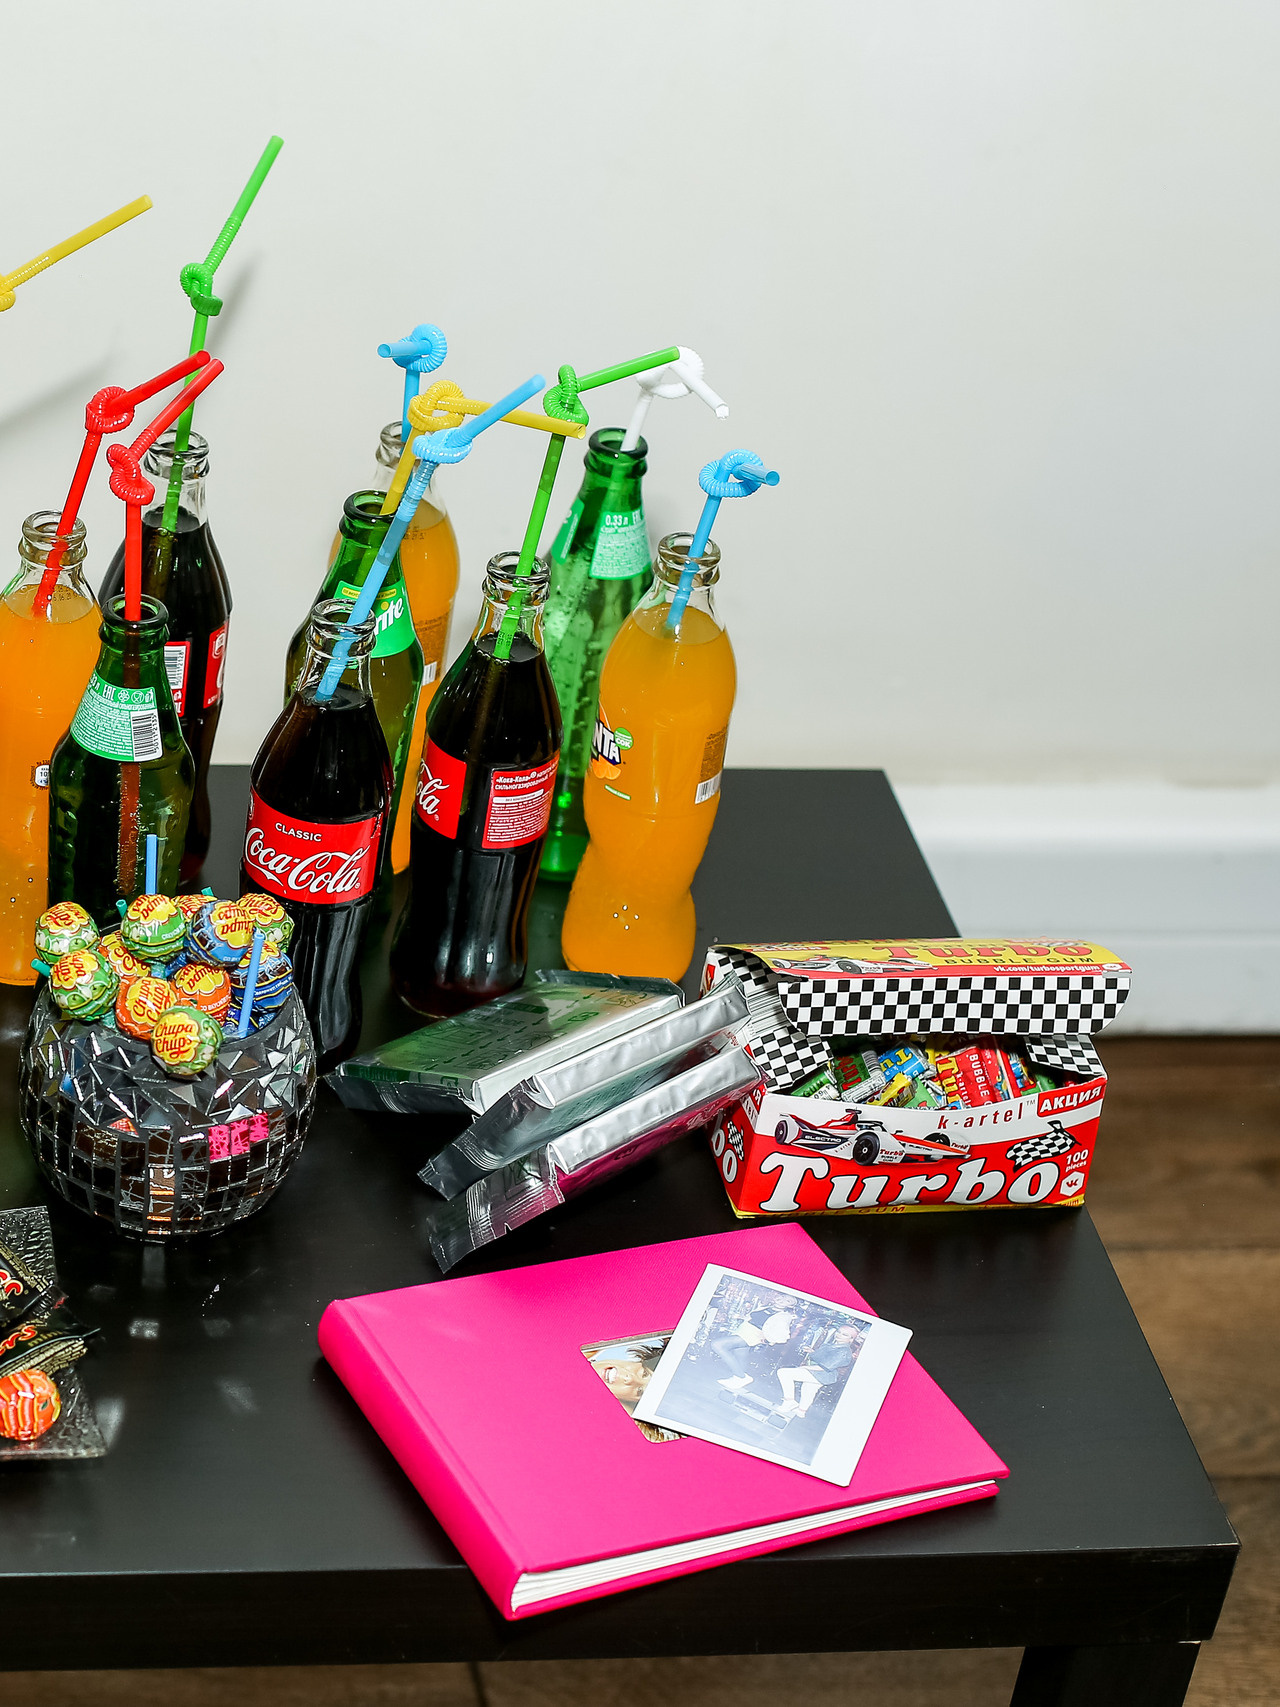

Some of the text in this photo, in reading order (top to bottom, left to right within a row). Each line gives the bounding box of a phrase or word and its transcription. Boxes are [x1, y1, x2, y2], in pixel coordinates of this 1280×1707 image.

[374, 597, 405, 637] rite
[592, 721, 621, 764] NTA
[275, 822, 323, 843] CLASSIC
[245, 827, 371, 894] Coca-Cola
[871, 944, 1093, 960] Turbo
[943, 956, 1095, 965] BUBBLE GUM
[993, 963, 1101, 974] vk.com/turbosportgum
[133, 979, 151, 1018] Chupa
[154, 1022, 193, 1038] Chupa
[154, 1035, 195, 1058] Chups
[936, 1056, 963, 1105] Tur
[970, 1053, 990, 1097] BUBBLE
[1039, 1086, 1102, 1113] АКЦИЯ
[937, 1102, 1023, 1130] k-artel
[804, 1134, 842, 1143] ELECTRO
[879, 1148, 906, 1156] Turbo
[1066, 1149, 1089, 1165] 100
[1065, 1160, 1087, 1172] pieces
[759, 1151, 1060, 1212] Turbo
